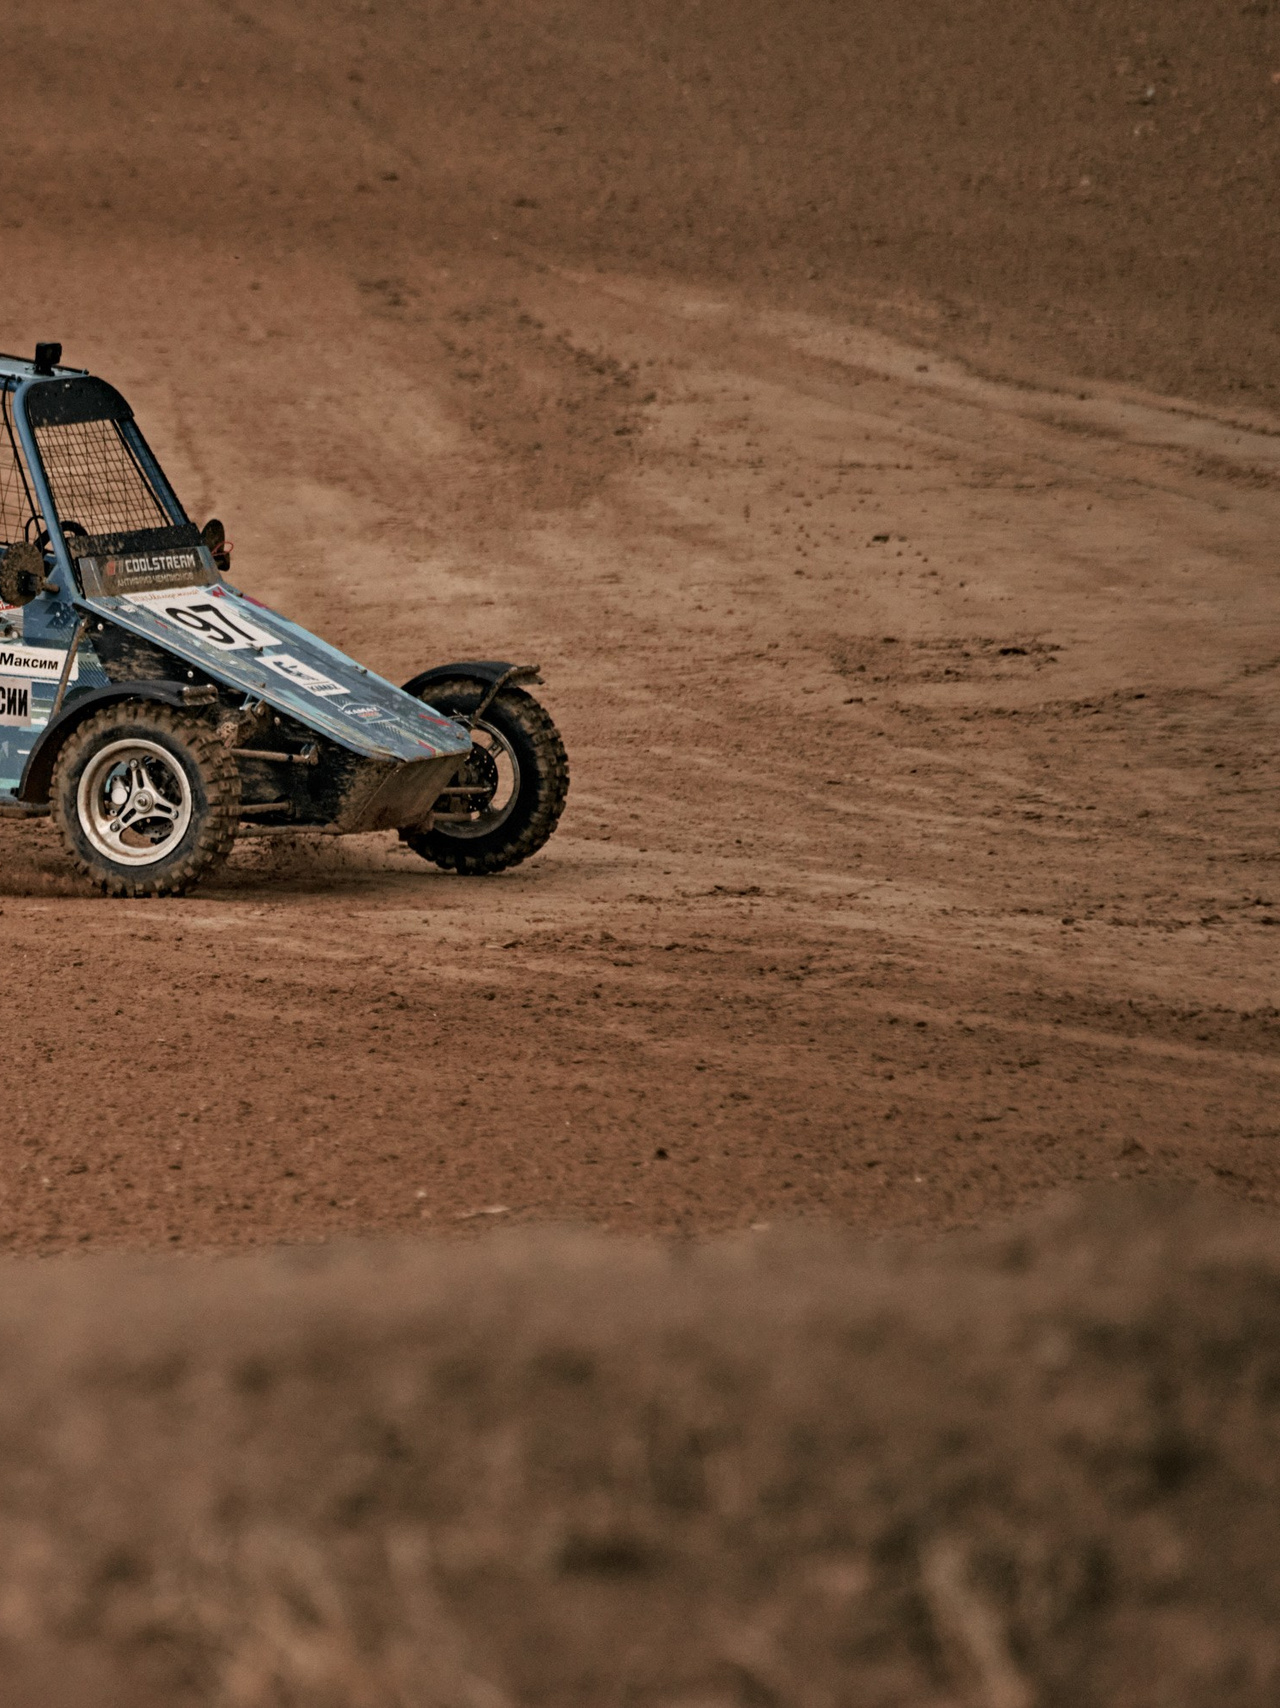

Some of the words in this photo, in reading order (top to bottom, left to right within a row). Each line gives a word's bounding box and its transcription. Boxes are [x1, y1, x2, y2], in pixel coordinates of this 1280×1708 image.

[125, 554, 196, 574] COOLSTREAM
[165, 603, 258, 645] 97
[0, 652, 59, 671] Максим
